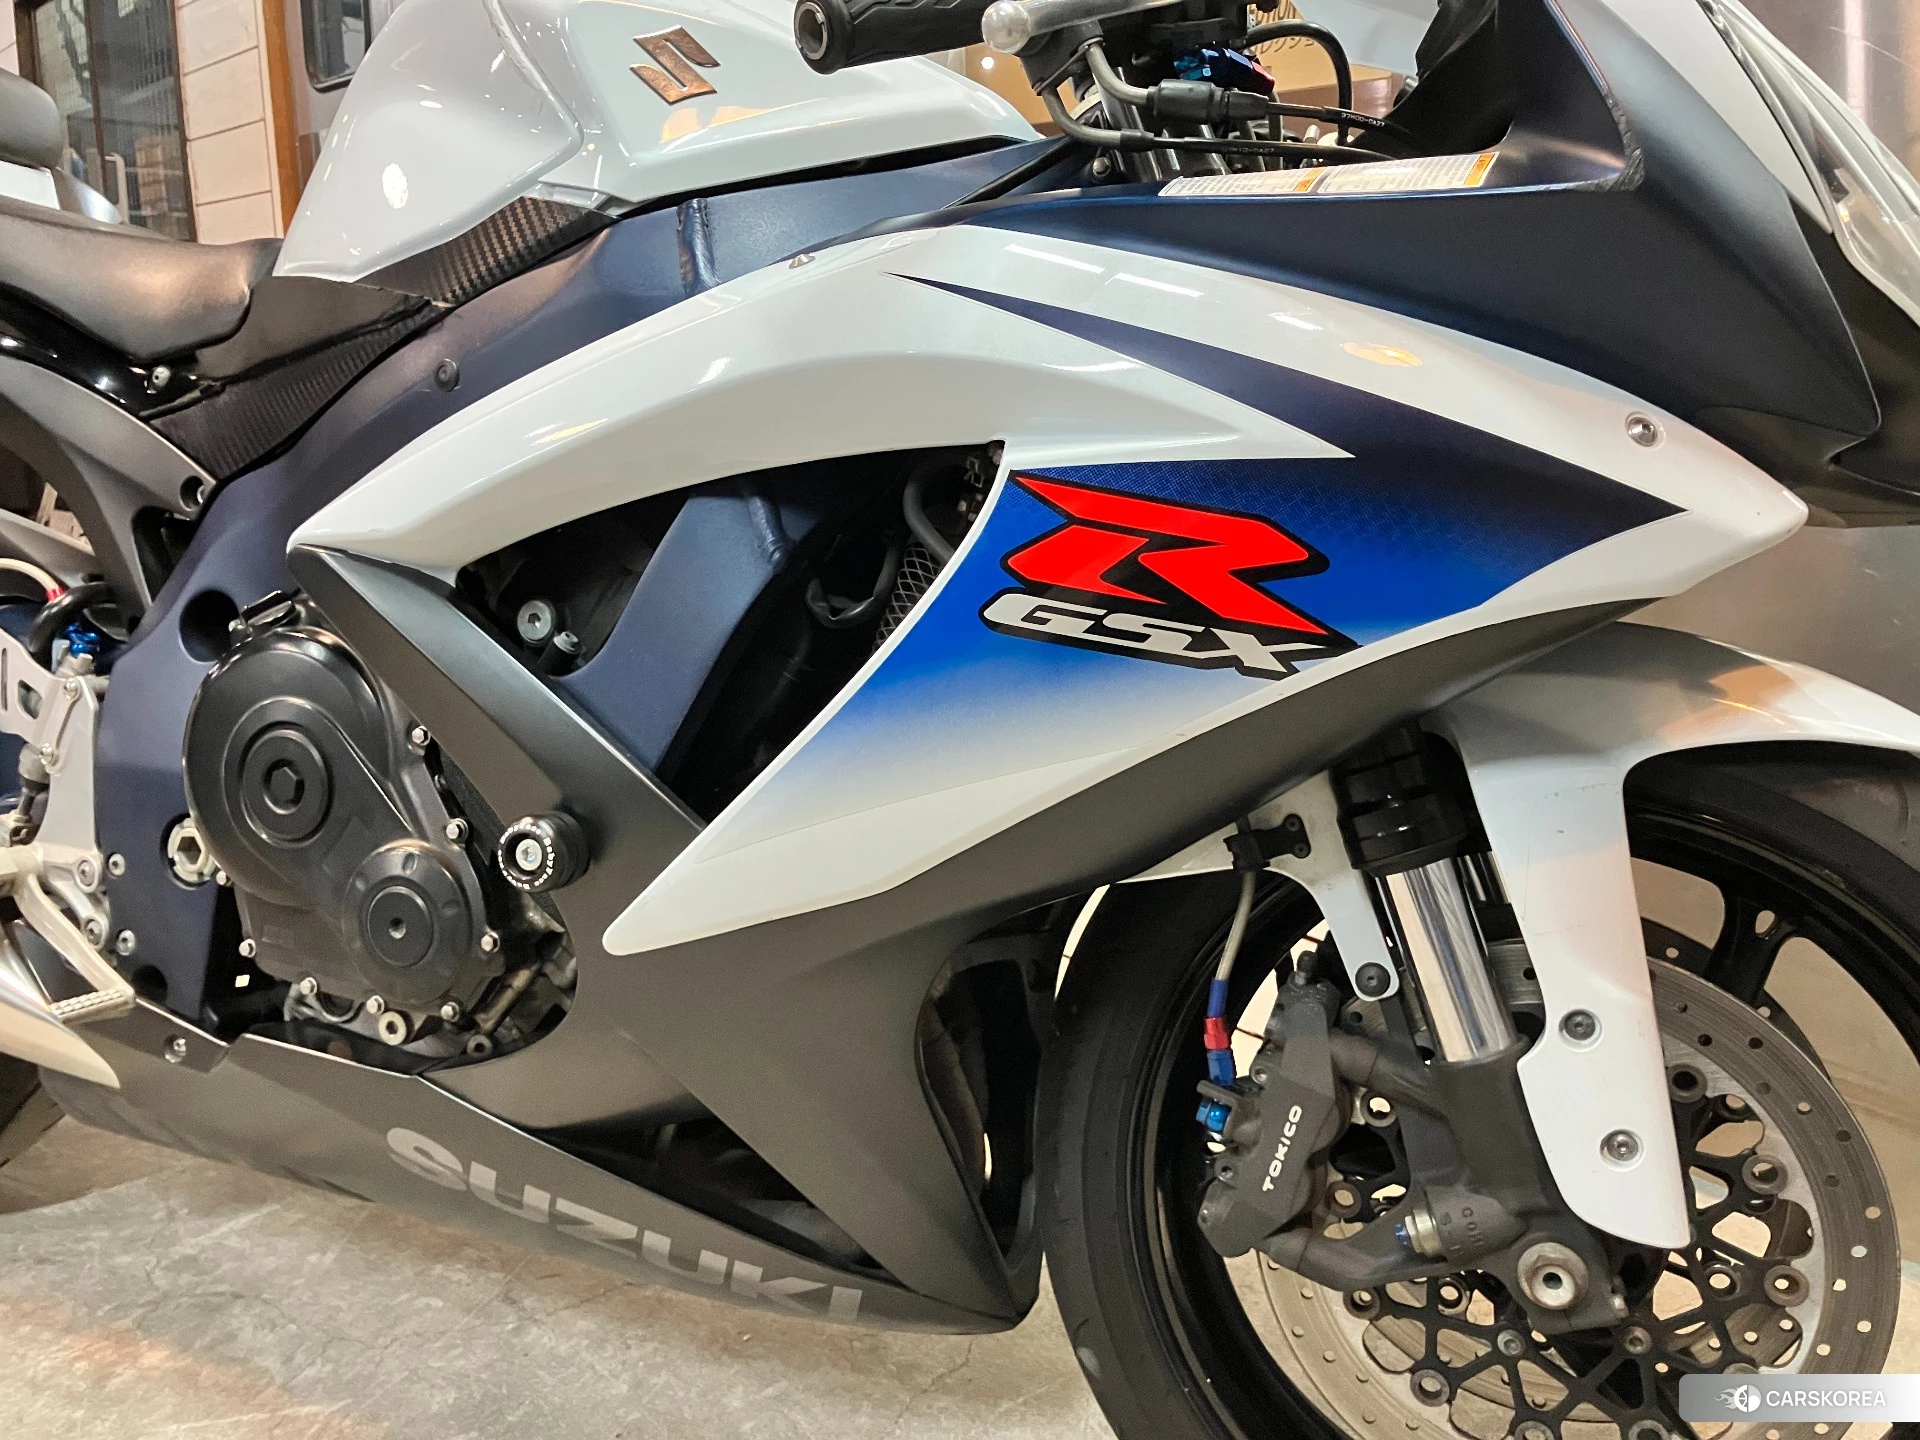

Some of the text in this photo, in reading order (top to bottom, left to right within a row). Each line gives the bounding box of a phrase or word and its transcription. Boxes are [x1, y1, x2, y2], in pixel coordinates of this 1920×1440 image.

[1006, 476, 1329, 635] R
[983, 593, 1331, 673] GSX
[1262, 1105, 1303, 1192] TOKICO
[386, 1126, 862, 1321] SUZUKI
